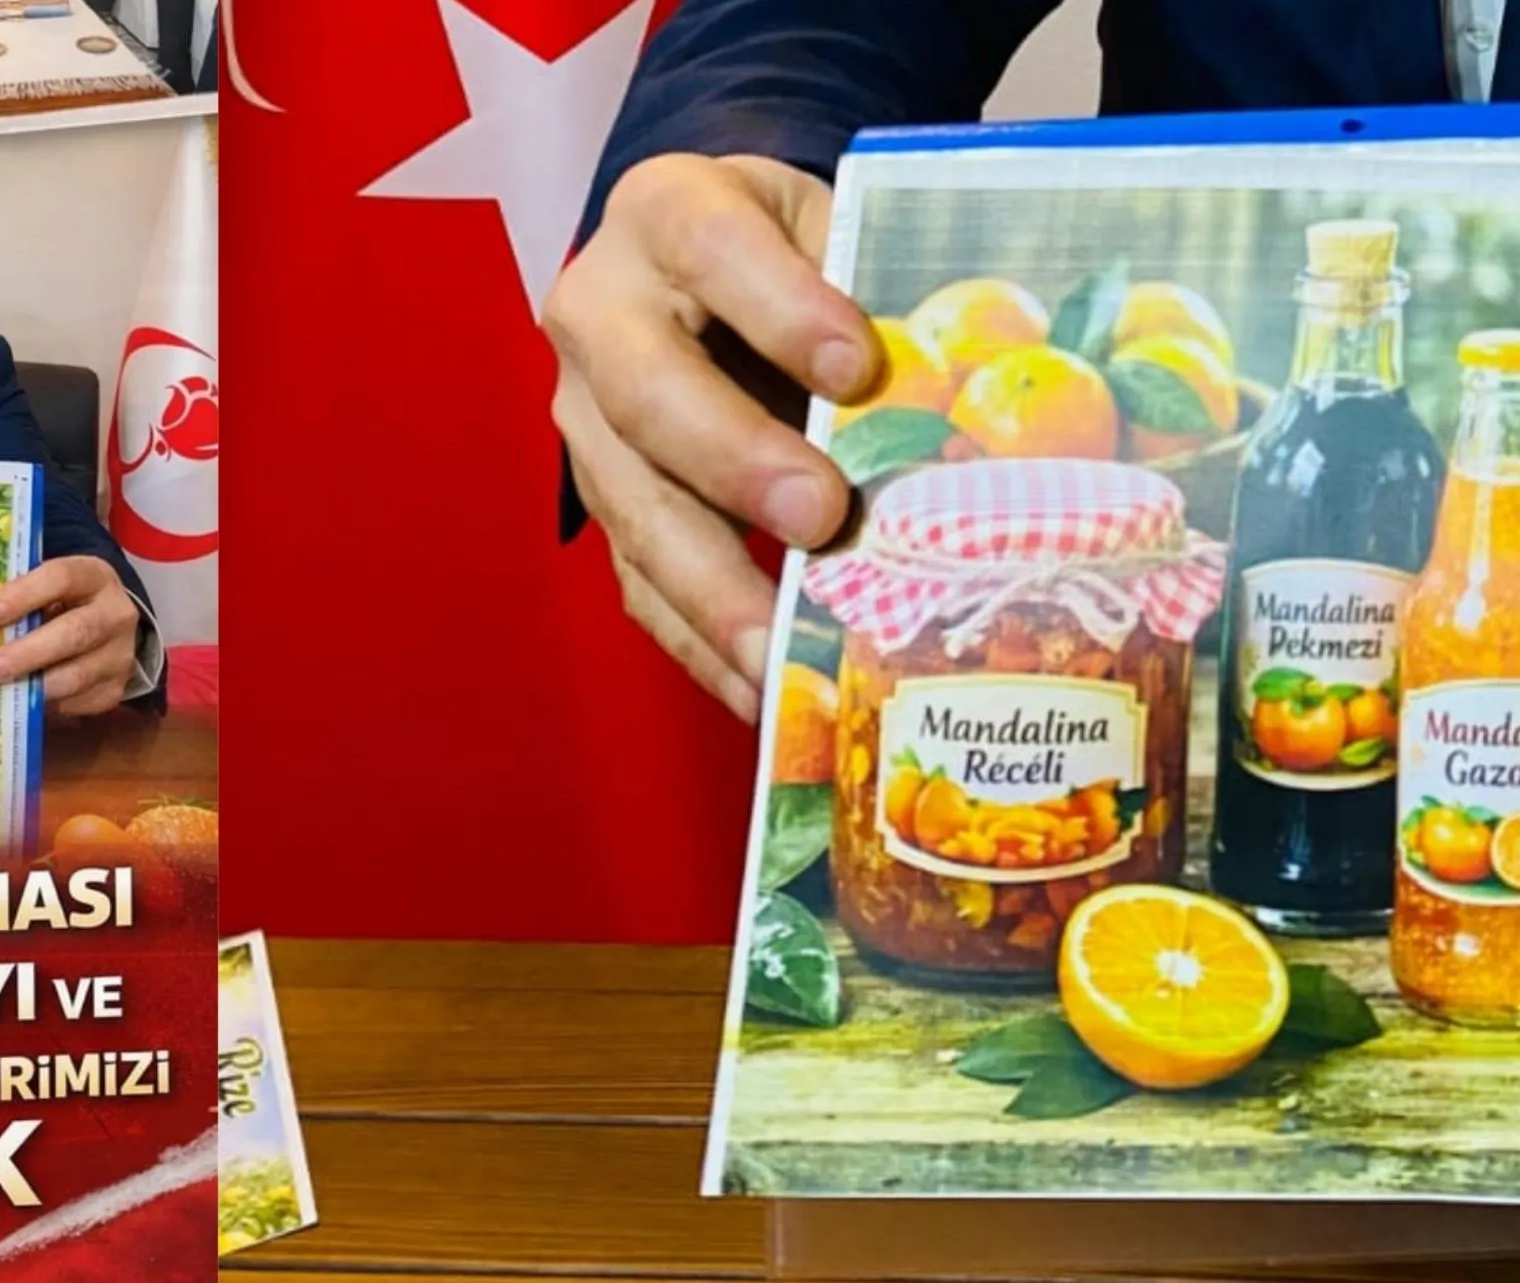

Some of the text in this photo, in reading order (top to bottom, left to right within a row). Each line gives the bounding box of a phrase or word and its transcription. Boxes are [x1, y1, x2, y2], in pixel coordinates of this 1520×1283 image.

[1255, 591, 1396, 624] Mandalina
[1268, 625, 1384, 660] Pekmezi
[919, 704, 1109, 746] Mandalina
[218, 1036, 269, 1118] Rize
